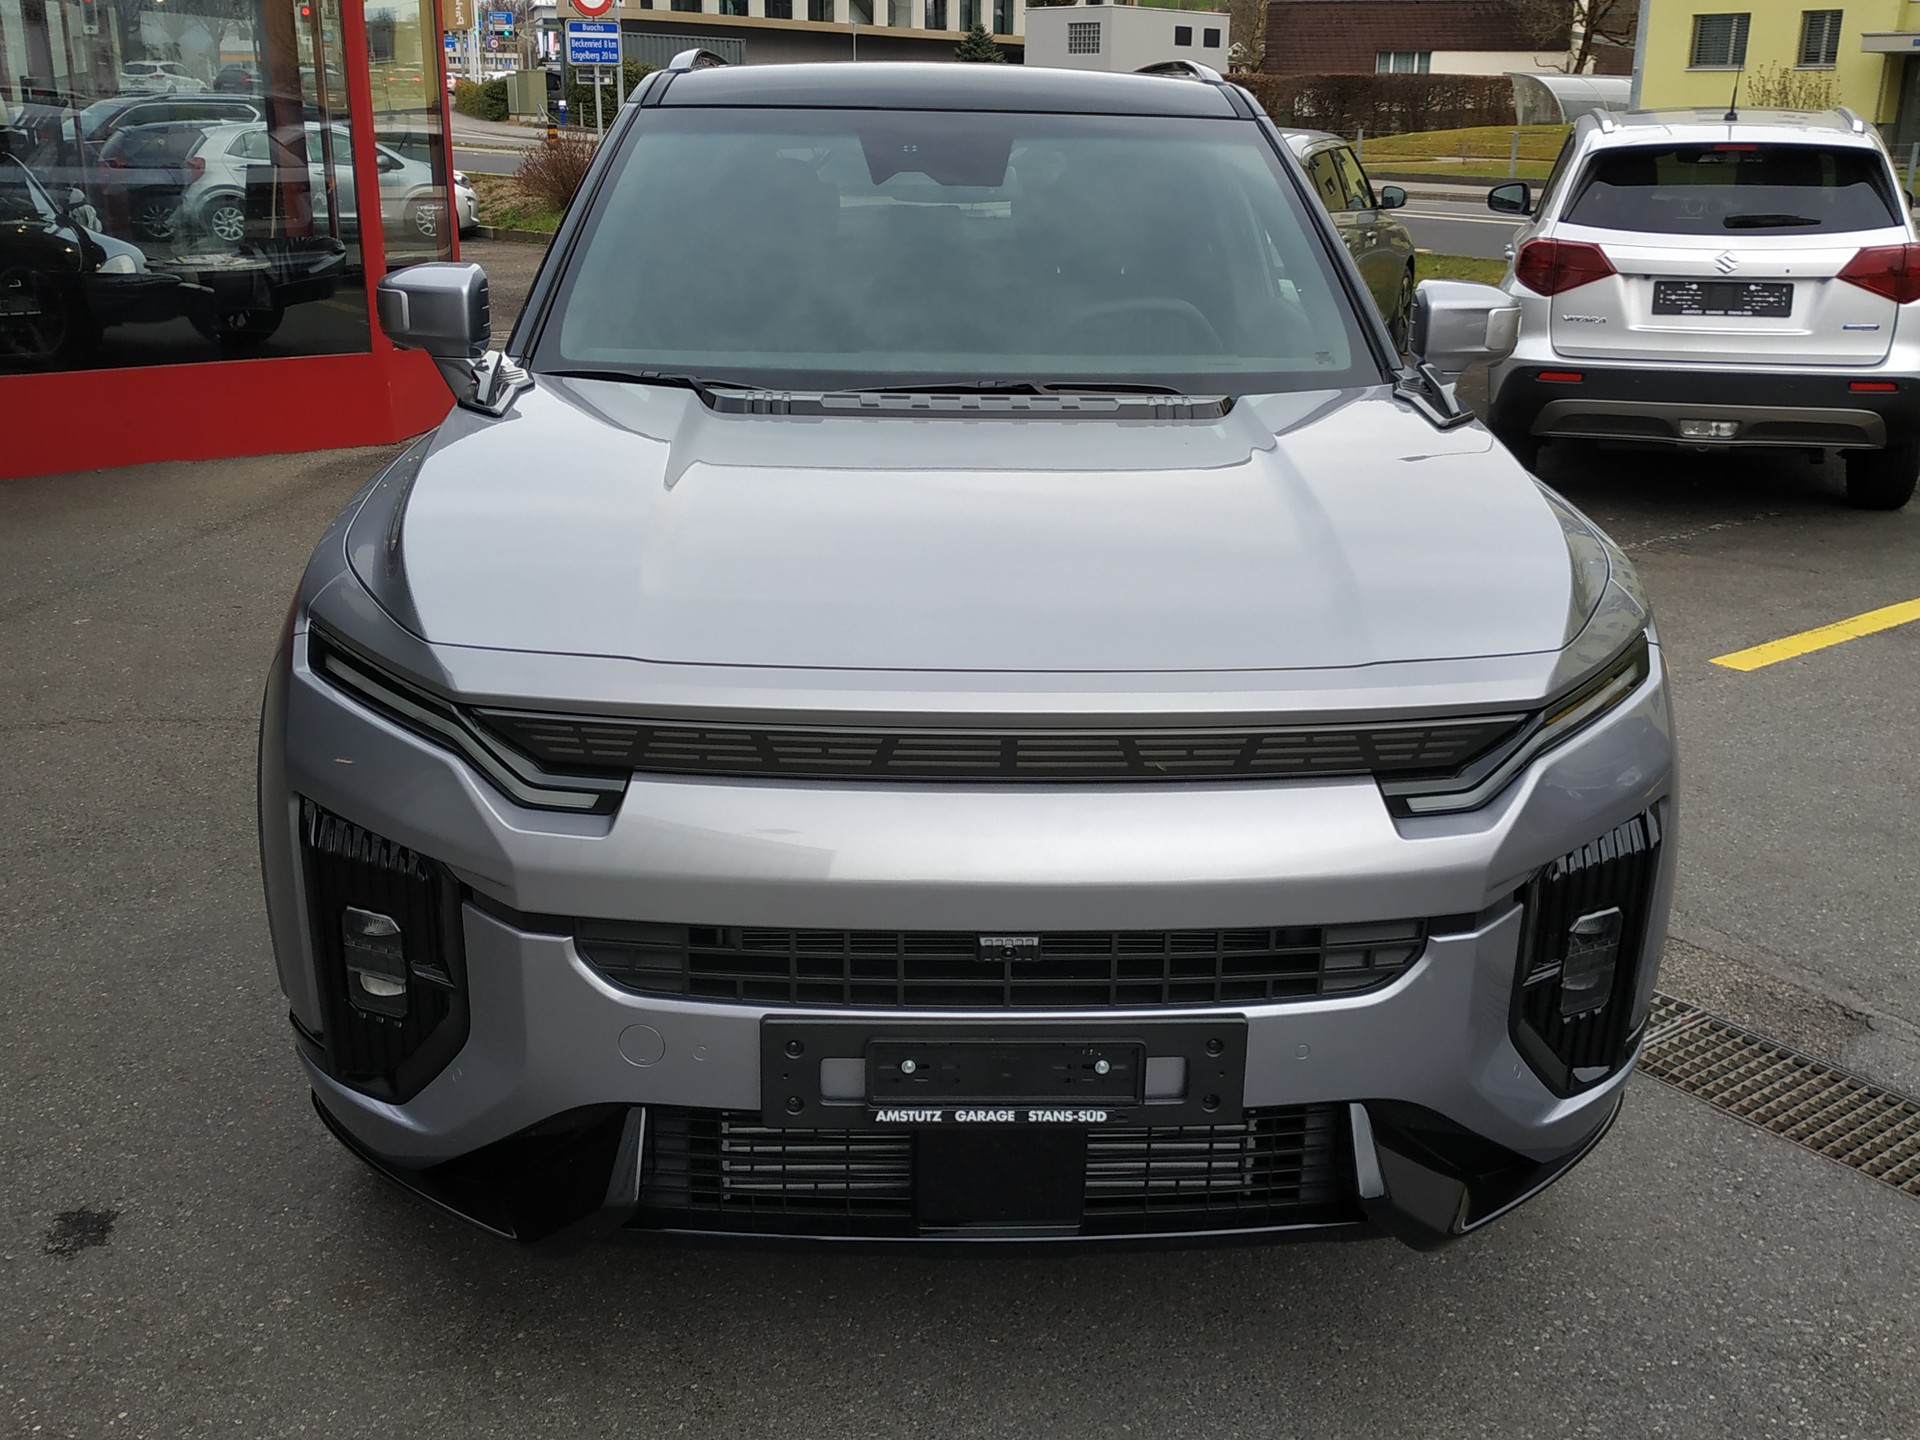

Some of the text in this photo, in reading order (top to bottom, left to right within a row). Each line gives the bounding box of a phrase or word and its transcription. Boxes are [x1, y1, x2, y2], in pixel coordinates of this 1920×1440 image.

[582, 23, 604, 32] Buochs
[571, 39, 617, 49] Beckenried 8 km
[572, 51, 618, 62] Engelberg 20 km
[875, 1109, 1107, 1122] AMSTUTZ GARAGE STANS-SÜD
